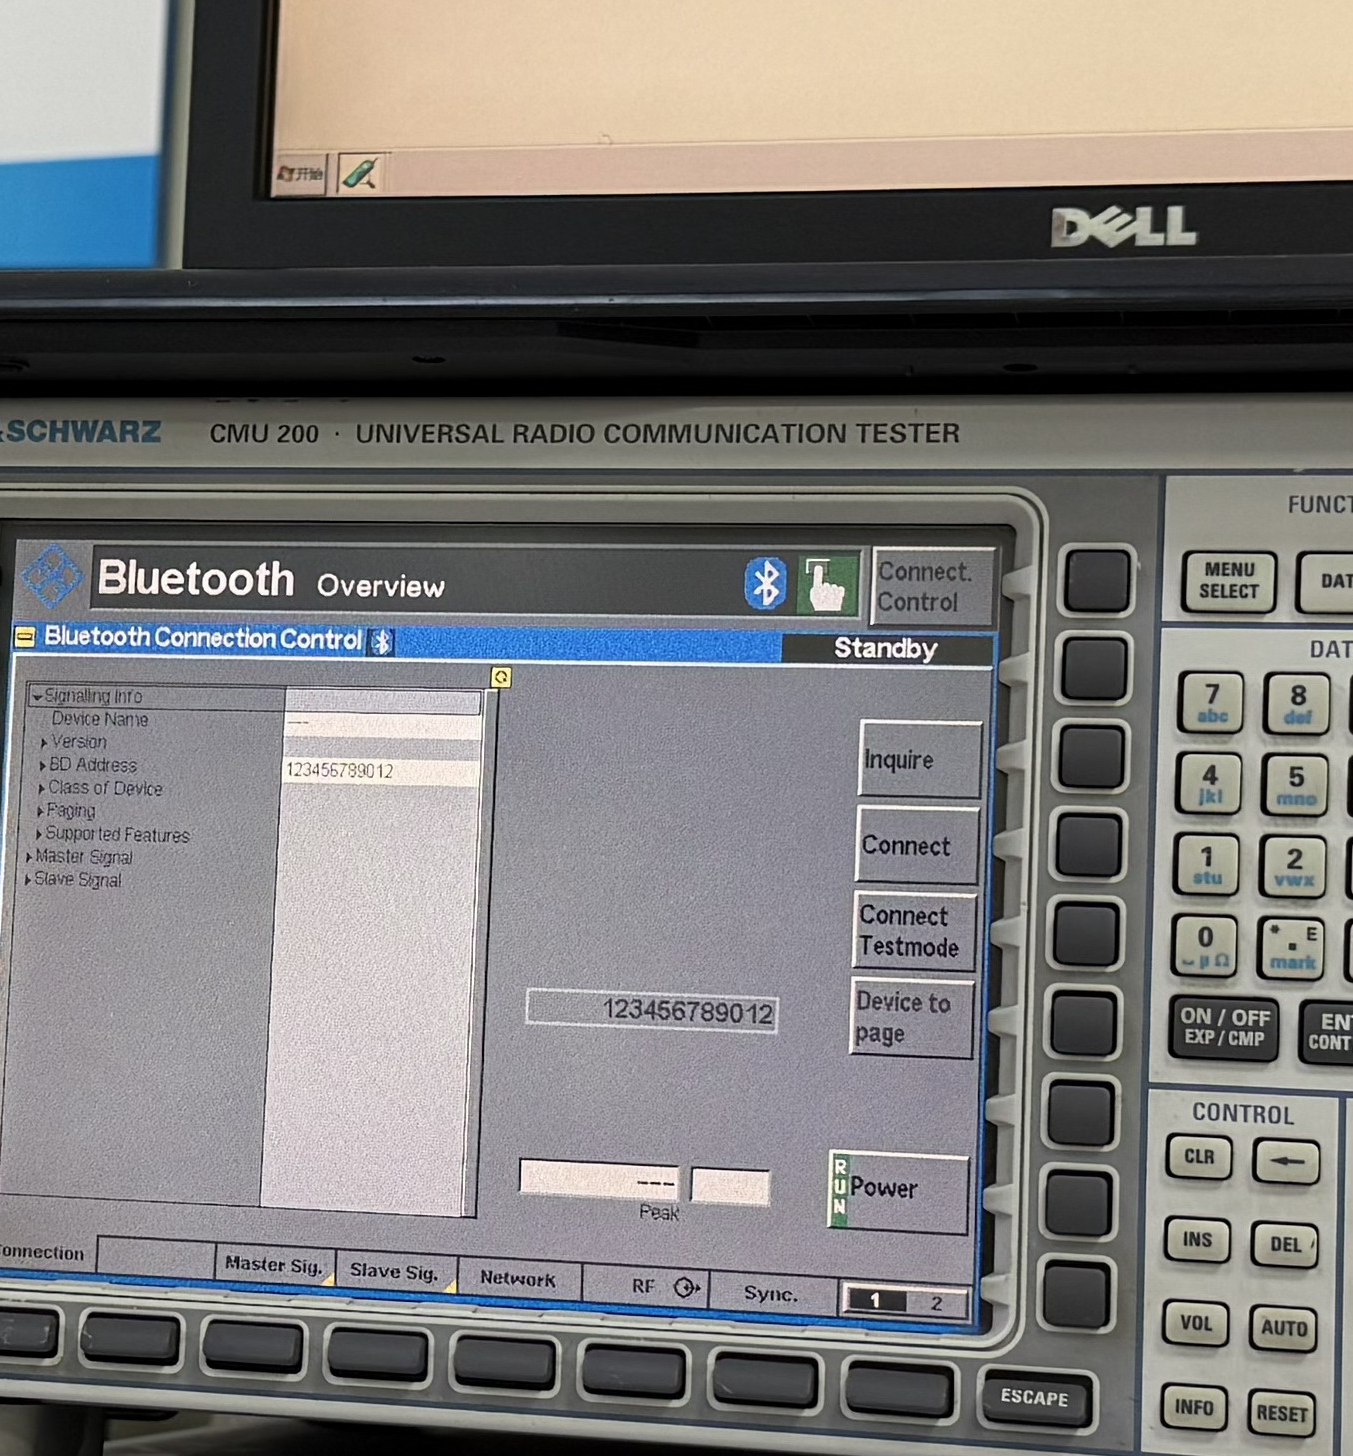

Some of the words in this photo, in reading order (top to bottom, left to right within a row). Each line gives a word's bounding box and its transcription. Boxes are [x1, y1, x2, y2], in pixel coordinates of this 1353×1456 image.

[1051, 205, 1198, 248] DELL
[210, 422, 269, 444] CMU
[276, 424, 319, 444] 200
[356, 422, 505, 444] UNIVERSAL
[512, 423, 596, 444] RADIO
[603, 422, 847, 444] COMMUNICATION
[855, 422, 960, 444] TESTER
[98, 558, 294, 596] Bluetooth
[317, 573, 446, 598] Overview
[878, 560, 973, 583] Connect.
[1204, 561, 1256, 578] MENU
[877, 590, 958, 613] Control
[1199, 582, 1260, 600] SELECT
[44, 624, 151, 647] Bluetooth
[154, 626, 277, 649] Connection
[280, 627, 363, 651] Control
[834, 636, 939, 664] Standby
[51, 709, 101, 727] Device
[104, 711, 149, 728] Name
[287, 761, 394, 779] 123456789012
[865, 748, 934, 775] Inquire
[862, 833, 951, 857] Connect
[859, 903, 949, 928] Connect
[858, 934, 960, 959] Testmode
[603, 997, 774, 1025] 123456789012
[856, 989, 923, 1013] Device
[928, 993, 952, 1014] to
[855, 1025, 906, 1049] page
[1192, 1101, 1295, 1126] CONTROL
[1184, 1147, 1215, 1165] CLR
[850, 1175, 919, 1200] Power
[1183, 1231, 1213, 1248] INS
[1270, 1235, 1303, 1254] DEL
[225, 1254, 286, 1273] Master
[290, 1258, 323, 1278] Sig.
[350, 1262, 401, 1279] Slave
[405, 1265, 439, 1285] Sig.
[480, 1269, 556, 1289] Network
[744, 1284, 799, 1304] Sync.
[1180, 1314, 1213, 1332] VOL
[1261, 1319, 1309, 1338] AUTO
[1000, 1387, 1069, 1408] ESCAPE
[1175, 1398, 1215, 1417] INFO
[1256, 1404, 1309, 1424] RESET
